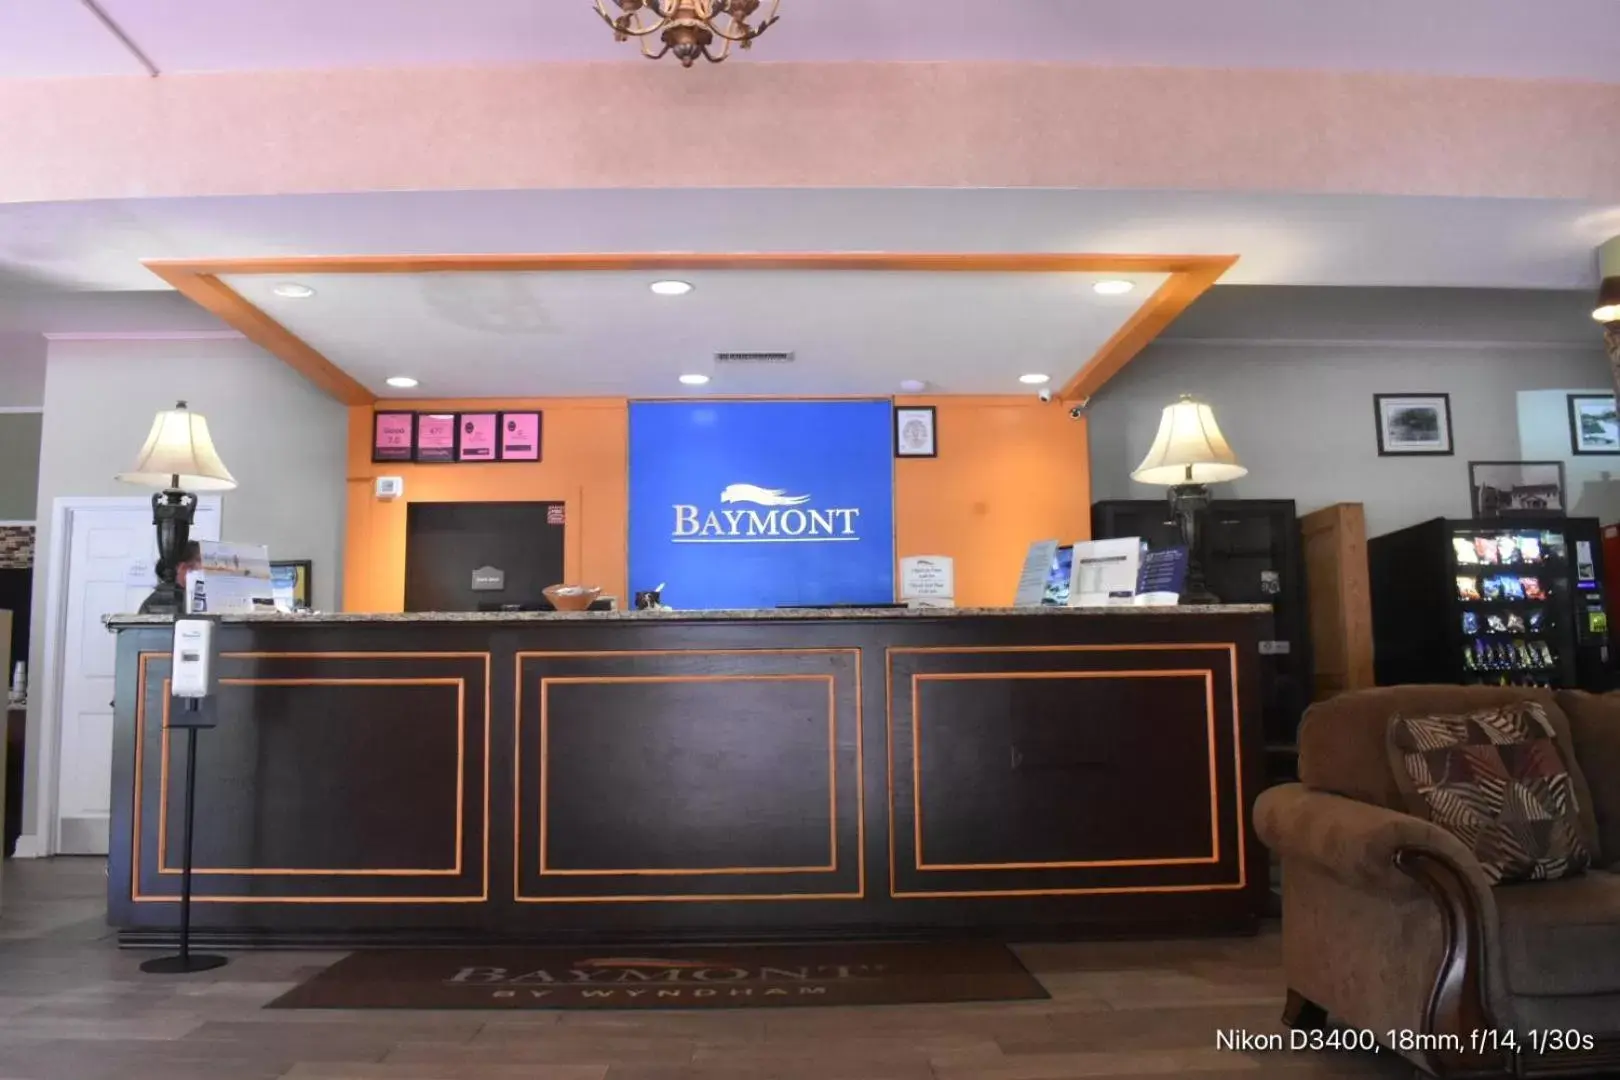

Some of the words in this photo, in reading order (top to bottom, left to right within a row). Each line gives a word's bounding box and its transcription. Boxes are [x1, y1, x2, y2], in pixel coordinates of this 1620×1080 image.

[672, 504, 860, 536] BAYMONT
[450, 966, 868, 982] BAYMONT
[493, 989, 551, 998] BY
[582, 987, 827, 998] WYNDHAM
